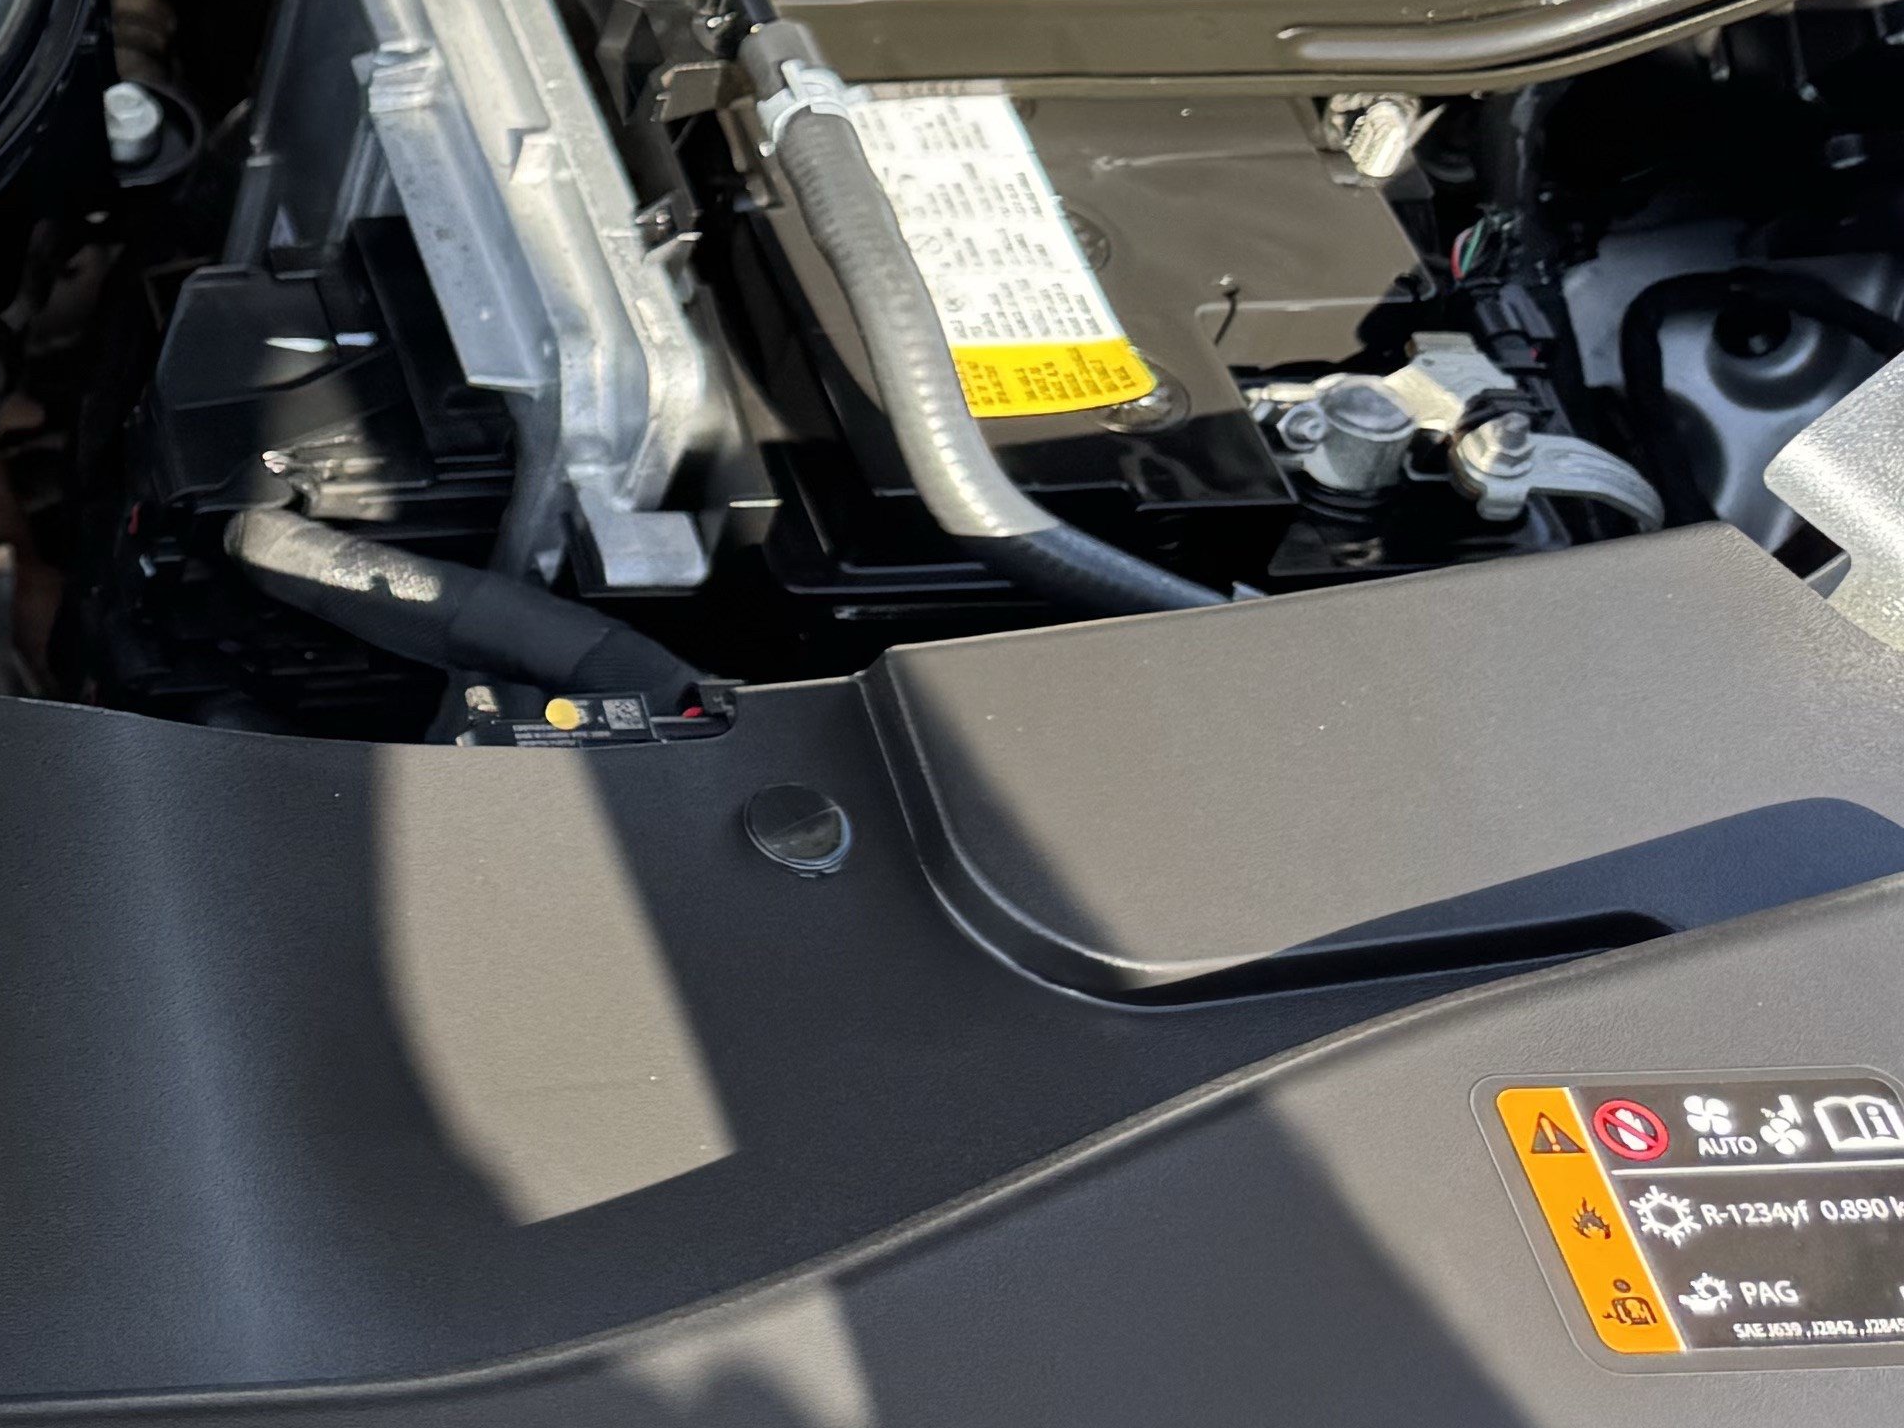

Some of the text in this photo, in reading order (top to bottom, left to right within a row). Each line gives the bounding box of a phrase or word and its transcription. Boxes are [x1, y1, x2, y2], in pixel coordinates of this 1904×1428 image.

[1698, 1135, 1758, 1156] AUTO
[1700, 1198, 1810, 1228] R-1234yf
[1820, 1197, 1890, 1222] 0.890
[1739, 1279, 1799, 1306] PAG
[1733, 1323, 1767, 1339] SAE
